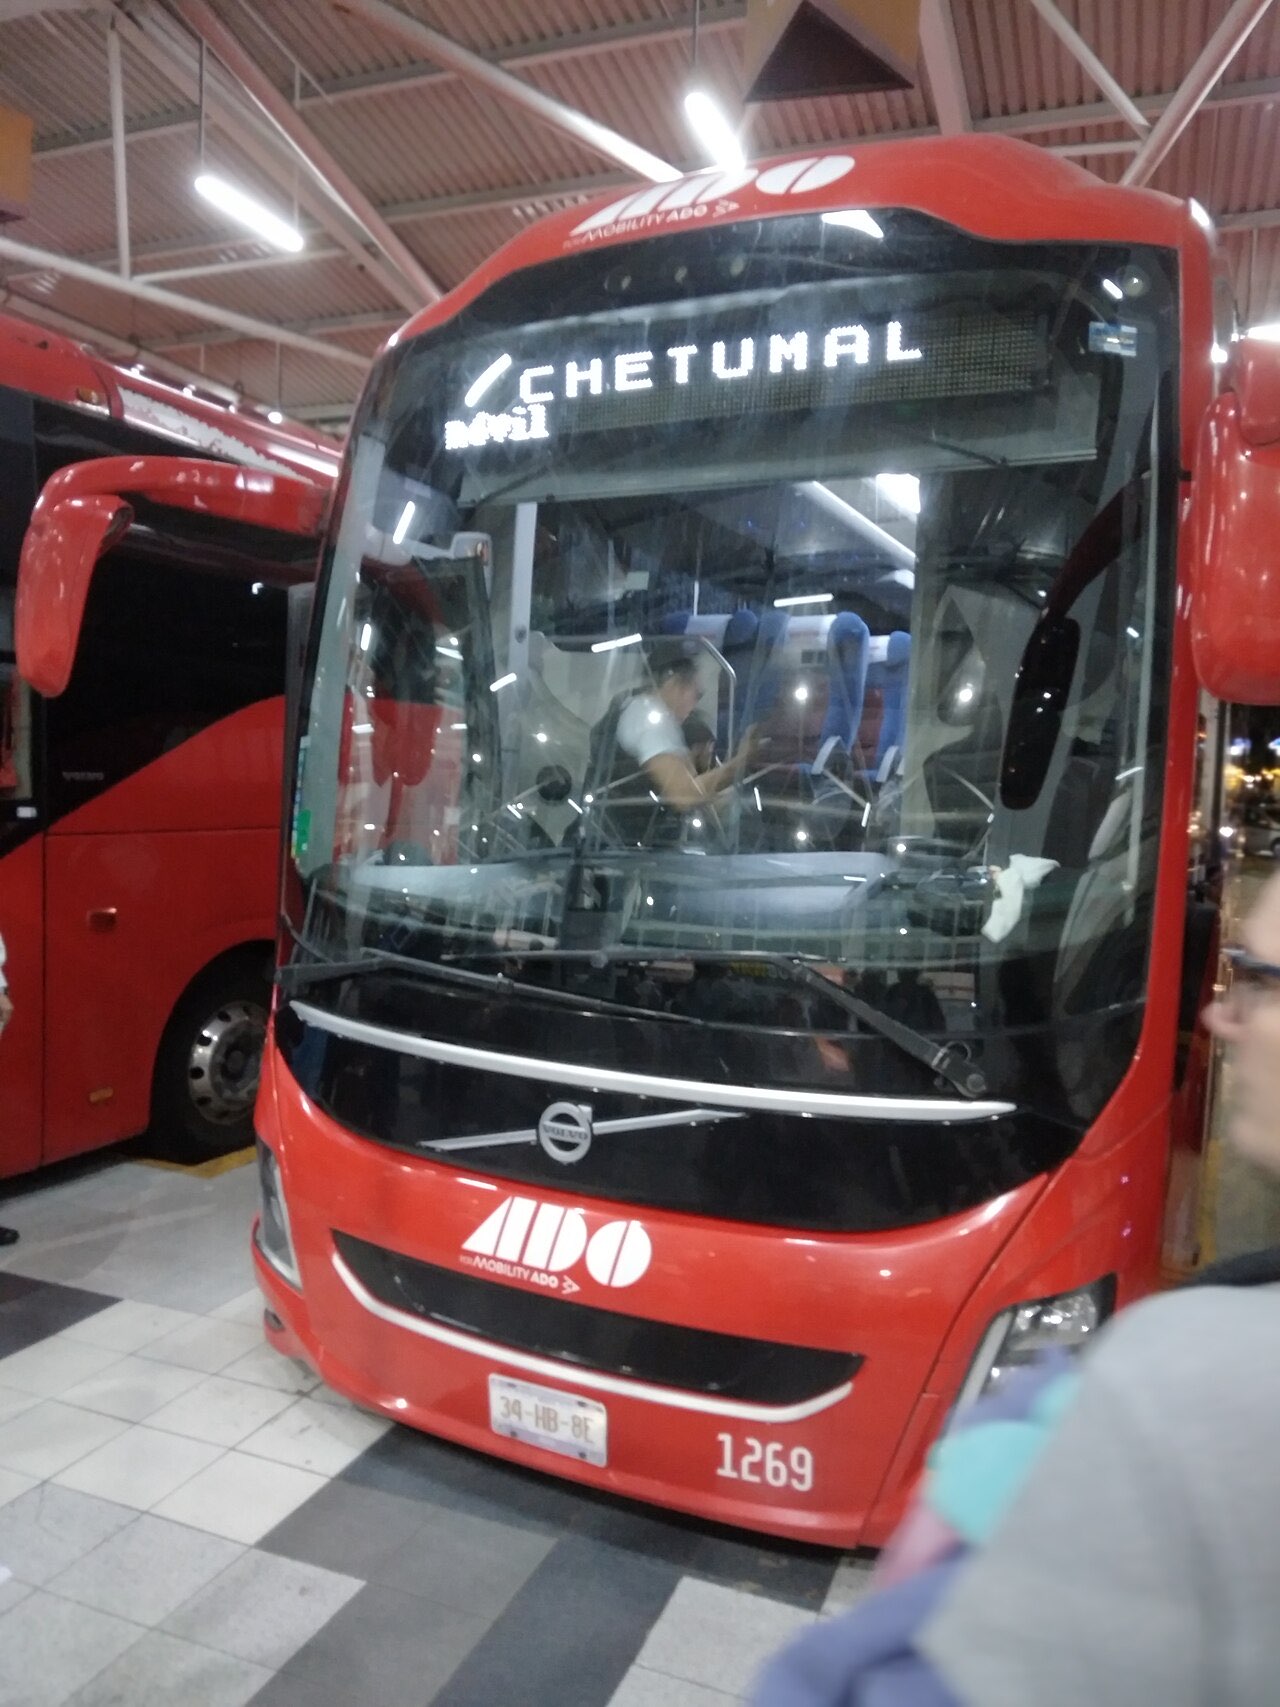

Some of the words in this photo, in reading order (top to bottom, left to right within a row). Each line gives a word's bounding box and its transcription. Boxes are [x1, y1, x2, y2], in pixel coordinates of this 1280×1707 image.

[569, 155, 855, 237] ADO
[582, 211, 666, 241] MOBILITY
[666, 204, 708, 223] ADO
[519, 321, 923, 404] CHETUMAL
[461, 1195, 653, 1288] ADO
[473, 1255, 530, 1280] MOBILITY
[530, 1272, 559, 1288] ADO
[715, 1431, 814, 1493] 1269
